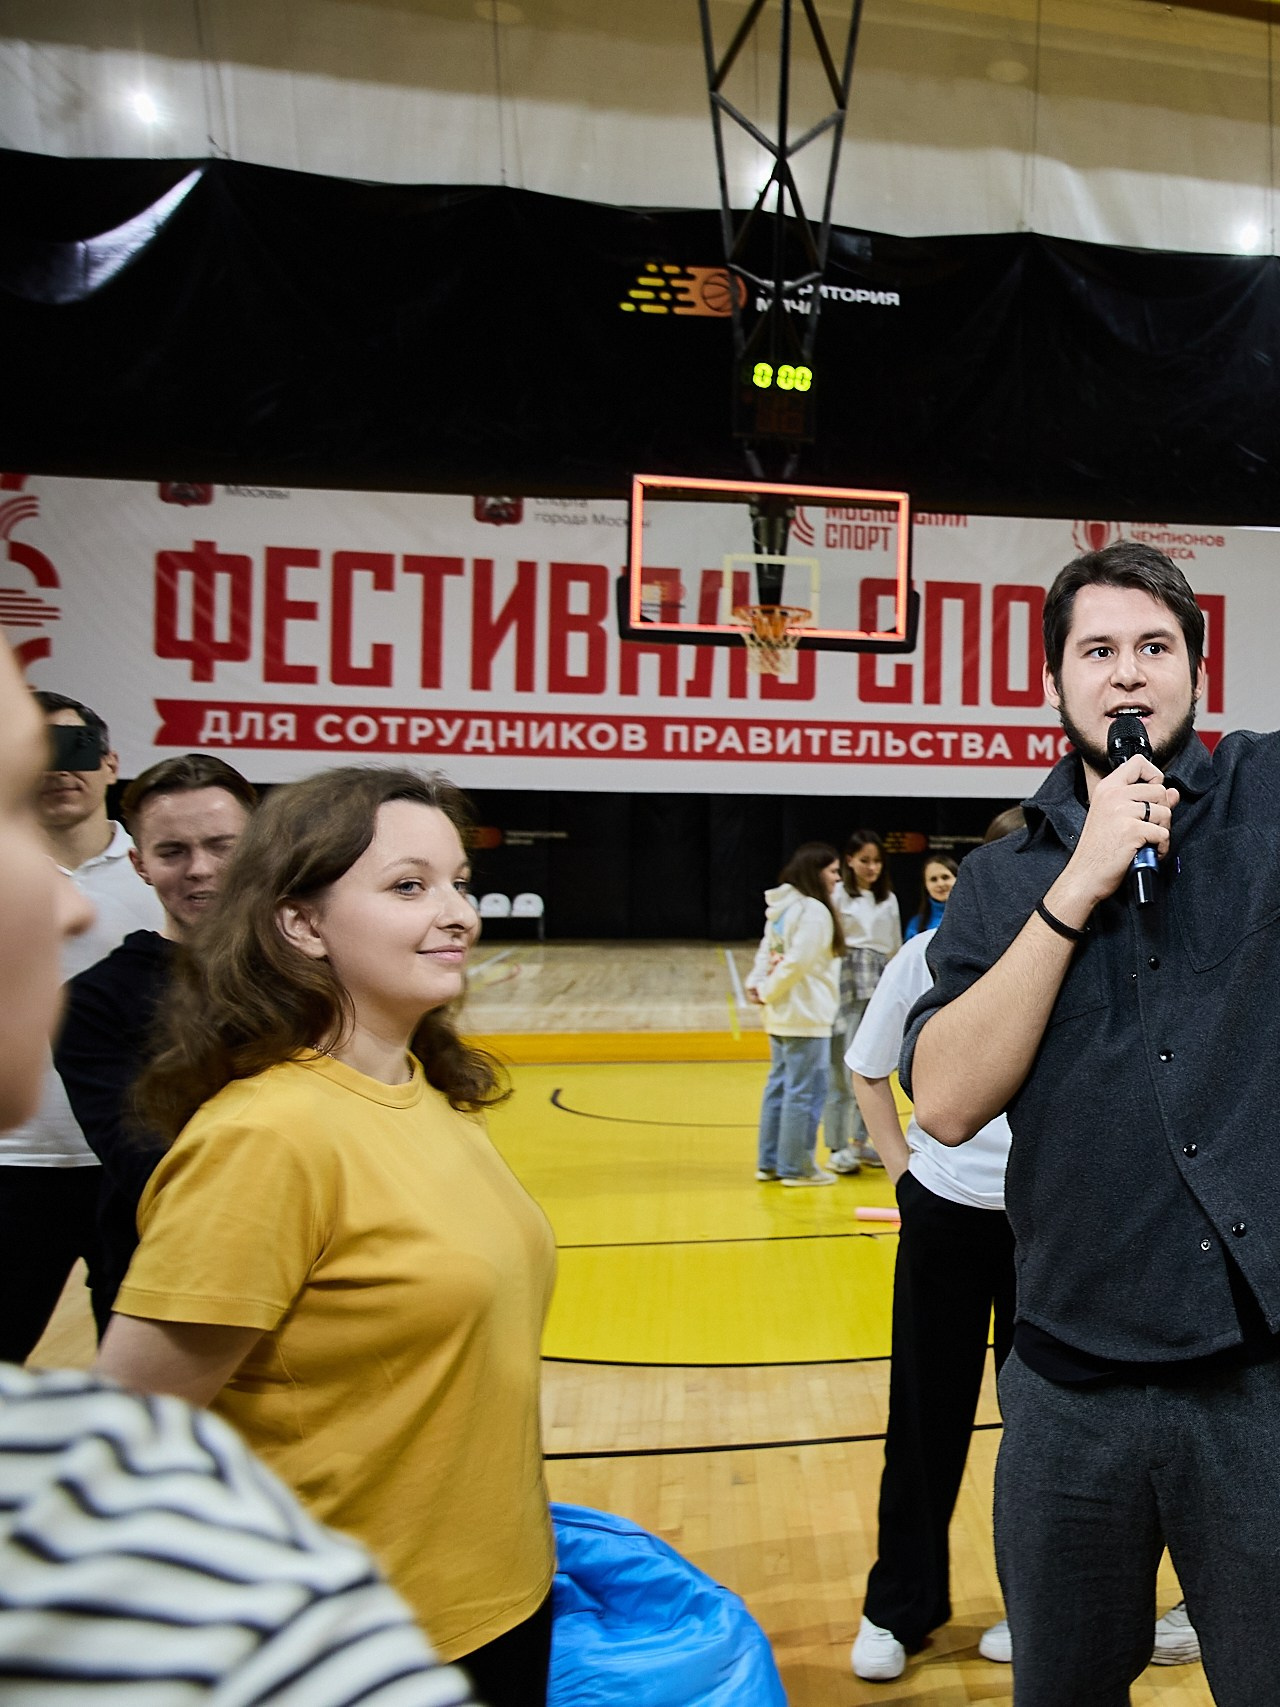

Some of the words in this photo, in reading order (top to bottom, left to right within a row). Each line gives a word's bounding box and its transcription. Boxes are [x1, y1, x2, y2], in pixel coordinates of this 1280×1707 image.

[825, 523, 892, 551] СПОРТ
[1130, 530, 1226, 548] ЧЕМПИОНОВ
[198, 709, 297, 745] ДЛЯ
[314, 713, 648, 753] СОТРУДНИКОВ
[663, 724, 1012, 760] ПРАВИТЕЛЬСТВА
